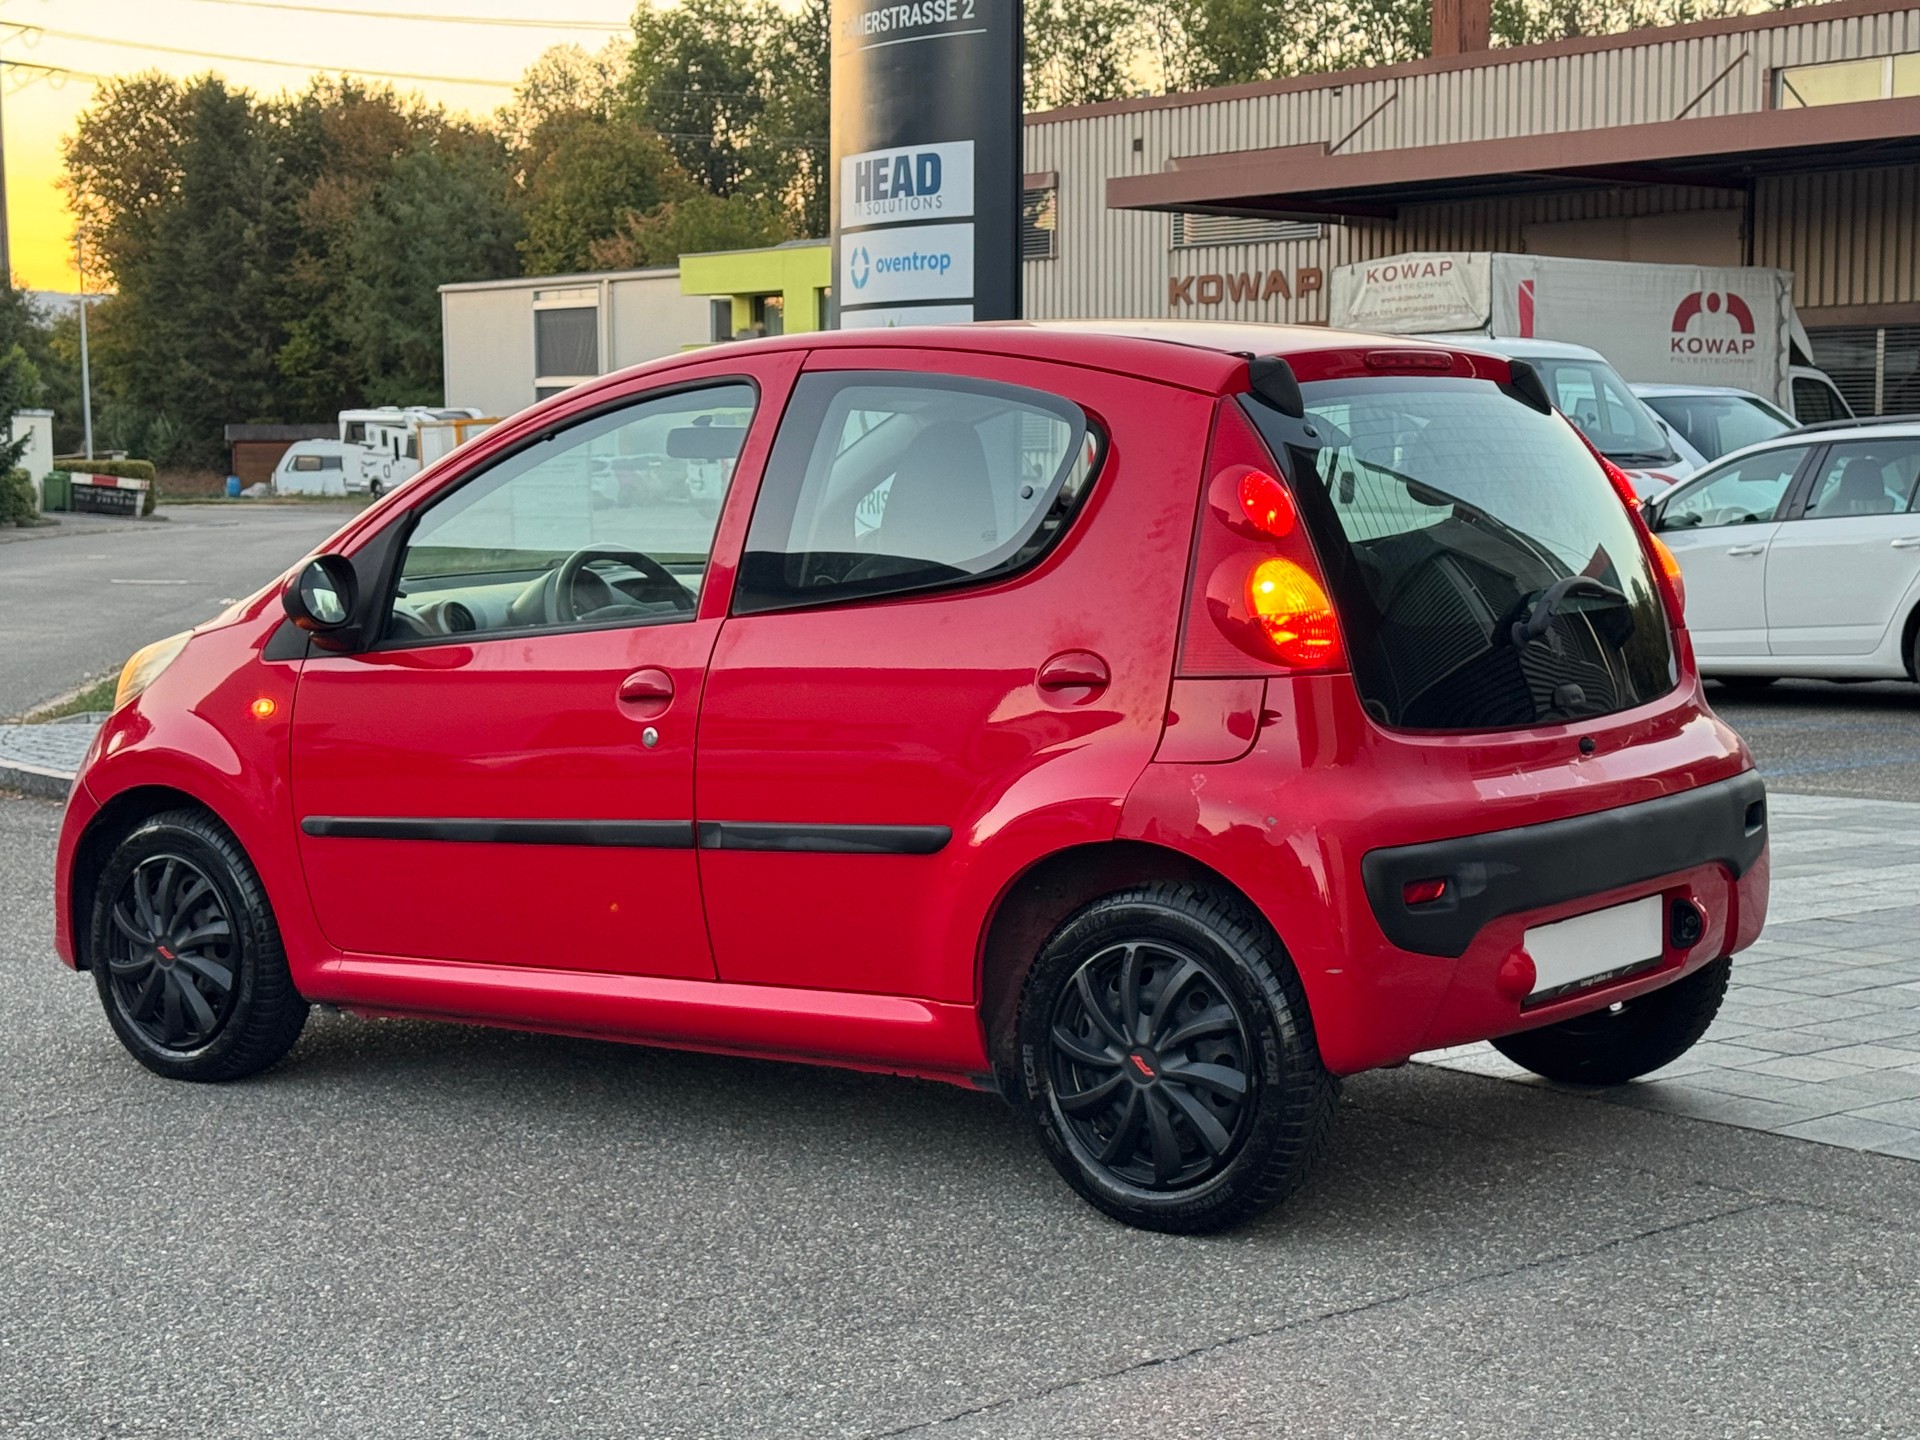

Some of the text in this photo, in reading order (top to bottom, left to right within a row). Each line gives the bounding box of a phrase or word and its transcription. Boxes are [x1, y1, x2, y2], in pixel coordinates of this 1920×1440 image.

[855, 152, 941, 203] HEAD
[866, 195, 942, 215] SOLUTIONS
[876, 252, 951, 275] oventrop
[1366, 260, 1453, 284] KOWAP
[1169, 267, 1322, 306] KOWAP
[1671, 337, 1755, 354] KOWAP
[1258, 1026, 1280, 1085] TECAR
[1022, 1044, 1036, 1100] TECAR
